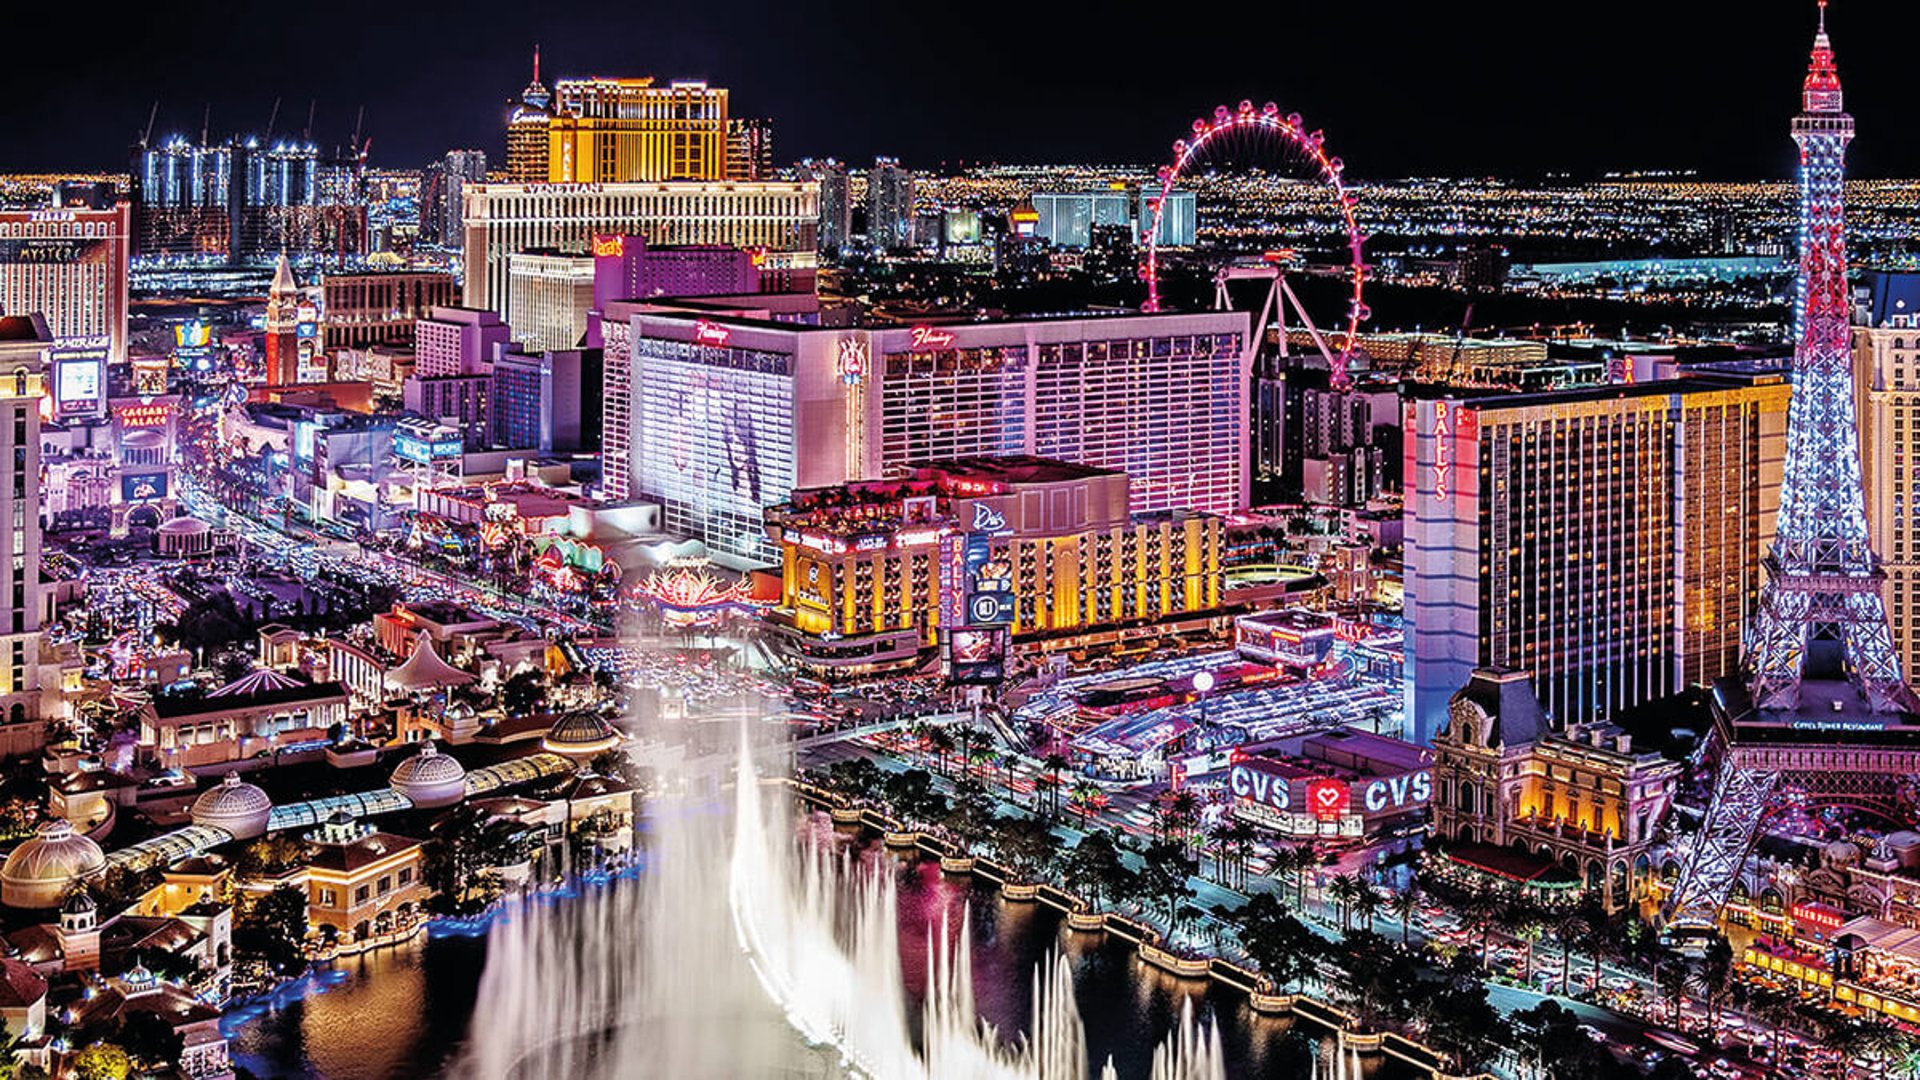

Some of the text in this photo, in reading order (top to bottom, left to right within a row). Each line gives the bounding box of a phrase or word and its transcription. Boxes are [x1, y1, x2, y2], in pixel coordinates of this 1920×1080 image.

[121, 406, 168, 416] CAESARS
[123, 417, 166, 427] PALACE
[1230, 765, 1290, 809] CVS
[1364, 772, 1432, 812] CVS
